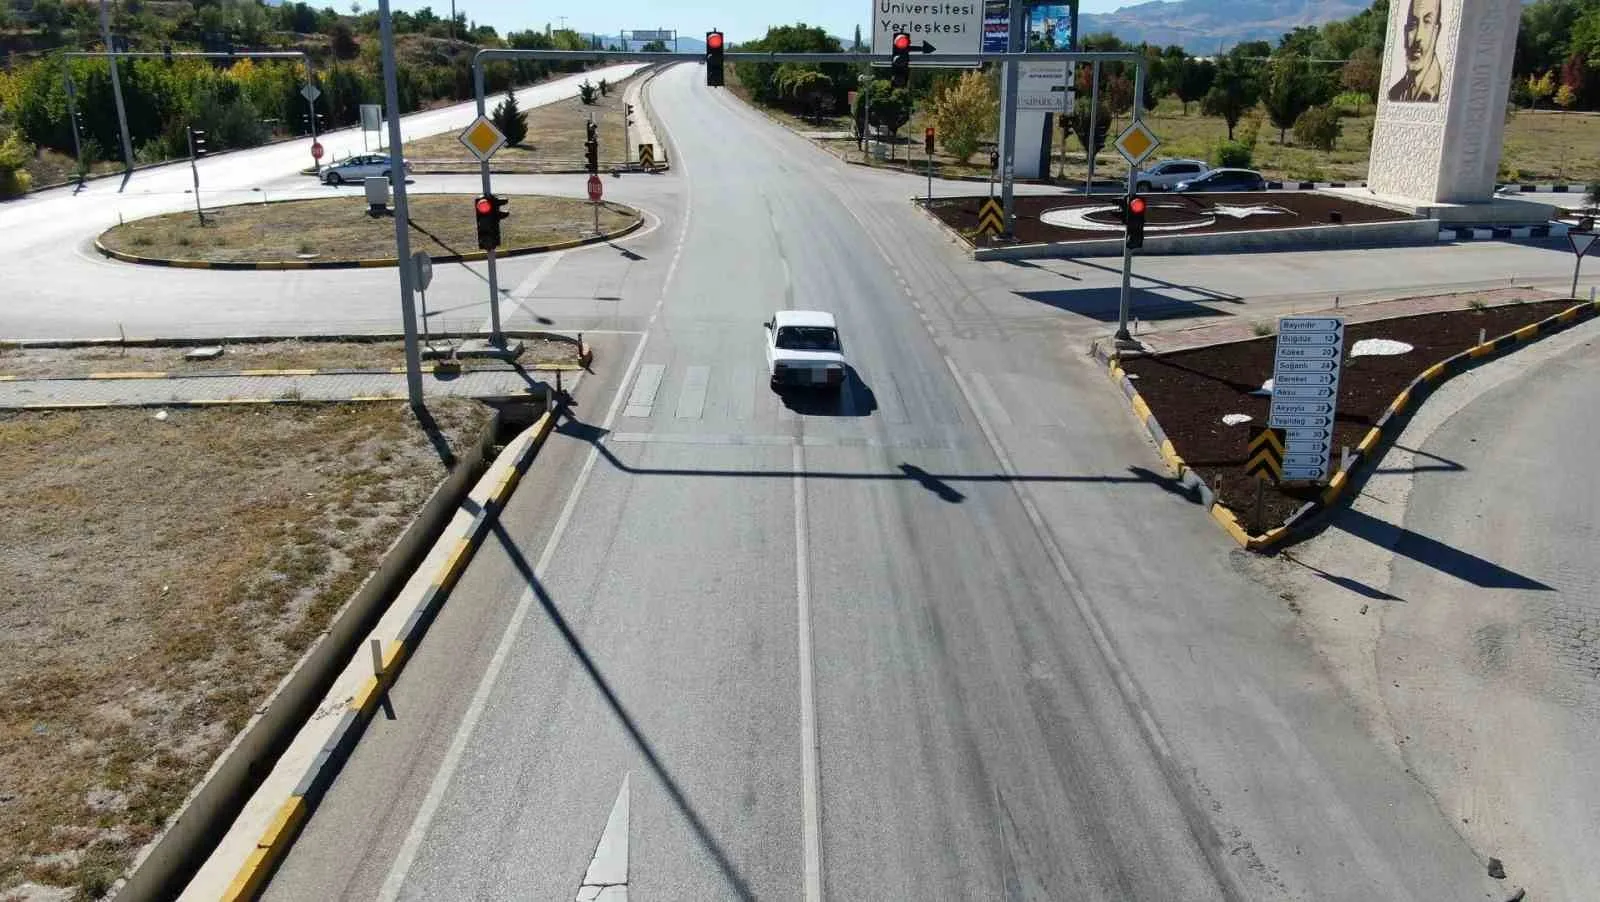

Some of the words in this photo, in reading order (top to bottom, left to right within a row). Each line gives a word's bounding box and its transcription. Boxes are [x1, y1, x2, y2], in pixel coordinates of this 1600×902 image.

[881, 20, 966, 34] Yerleşkesi
[588, 183, 602, 193] DUR
[1283, 320, 1316, 330] Bayındır
